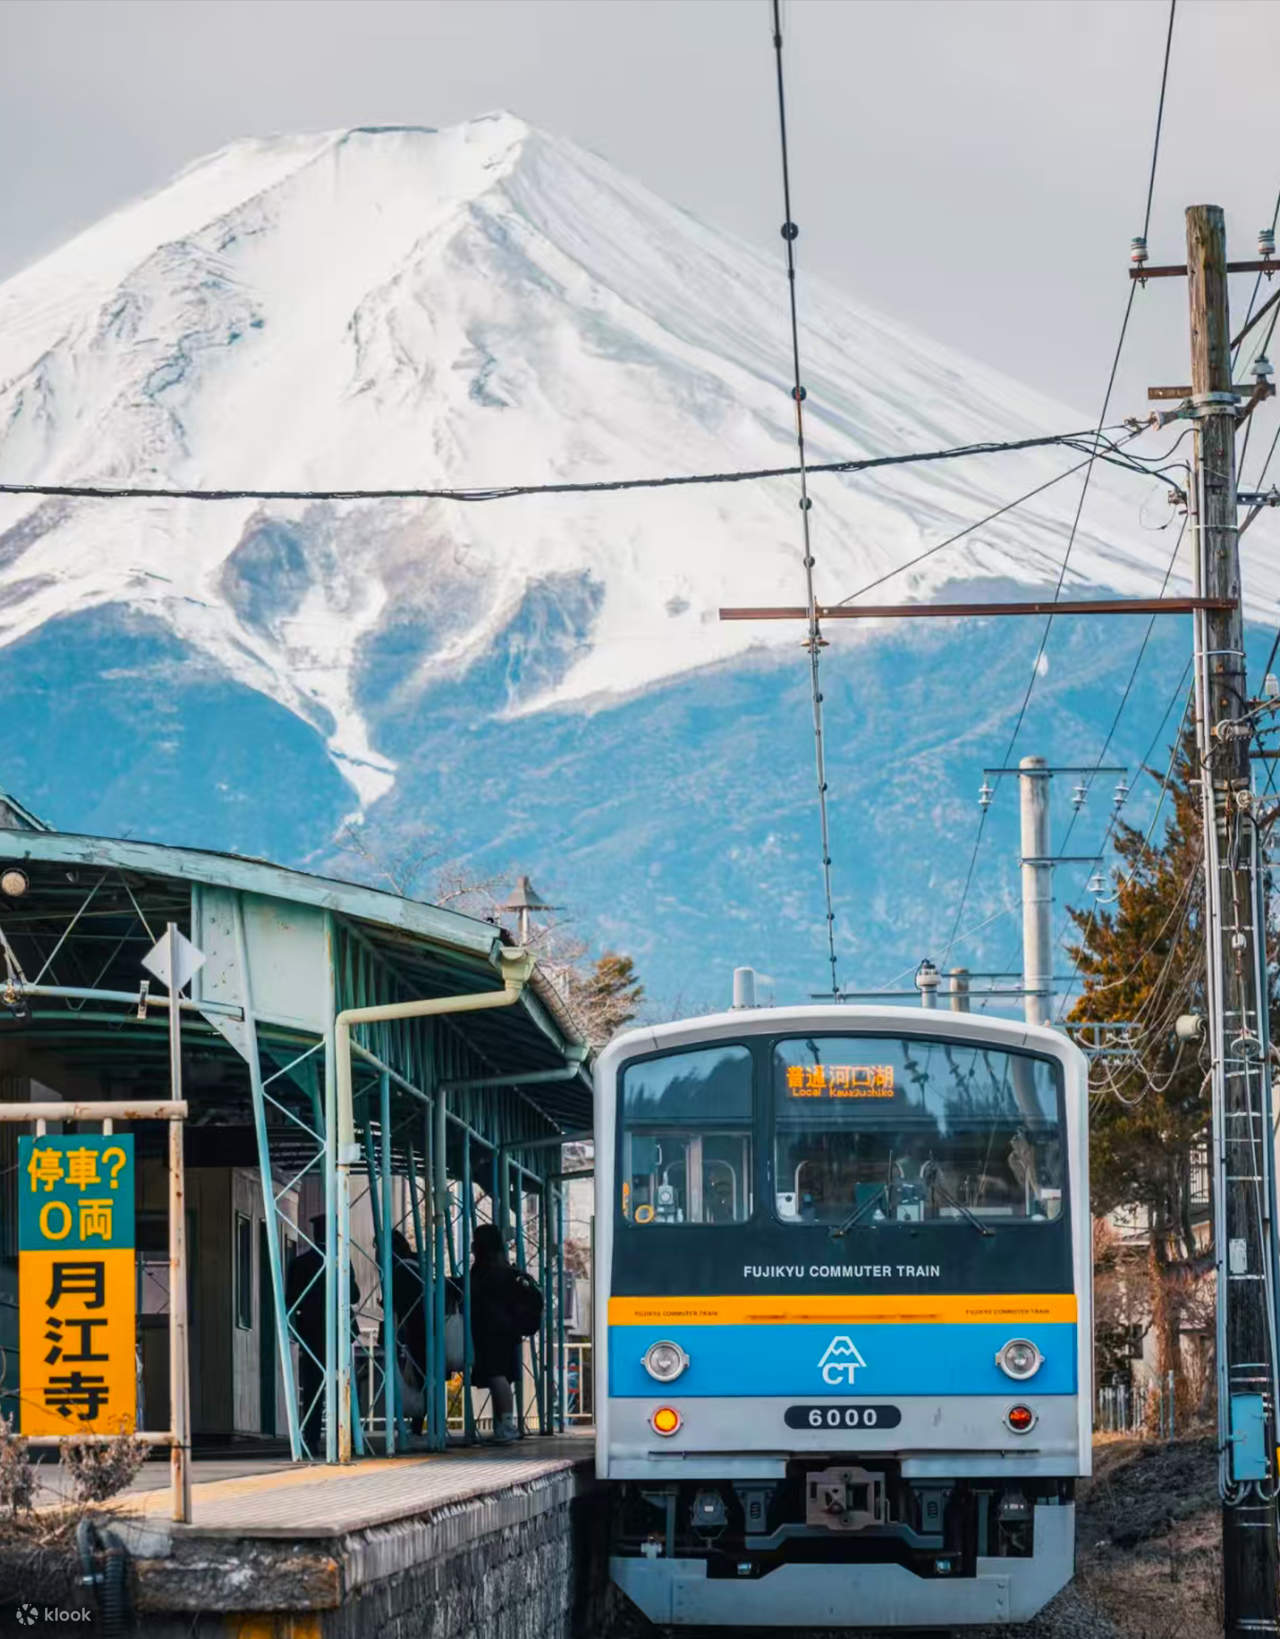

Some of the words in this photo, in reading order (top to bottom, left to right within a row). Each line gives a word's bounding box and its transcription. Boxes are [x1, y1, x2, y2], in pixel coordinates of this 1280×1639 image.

[829, 1065, 894, 1088] 河口湖
[792, 1088, 821, 1097] Local
[27, 1147, 127, 1192] 停車?
[743, 1265, 805, 1278] FUJIKYU
[809, 1265, 892, 1278] COMMUTER
[896, 1265, 941, 1277] TRAIN
[44, 1261, 109, 1421] 月江寺
[808, 1408, 877, 1427] 6000
